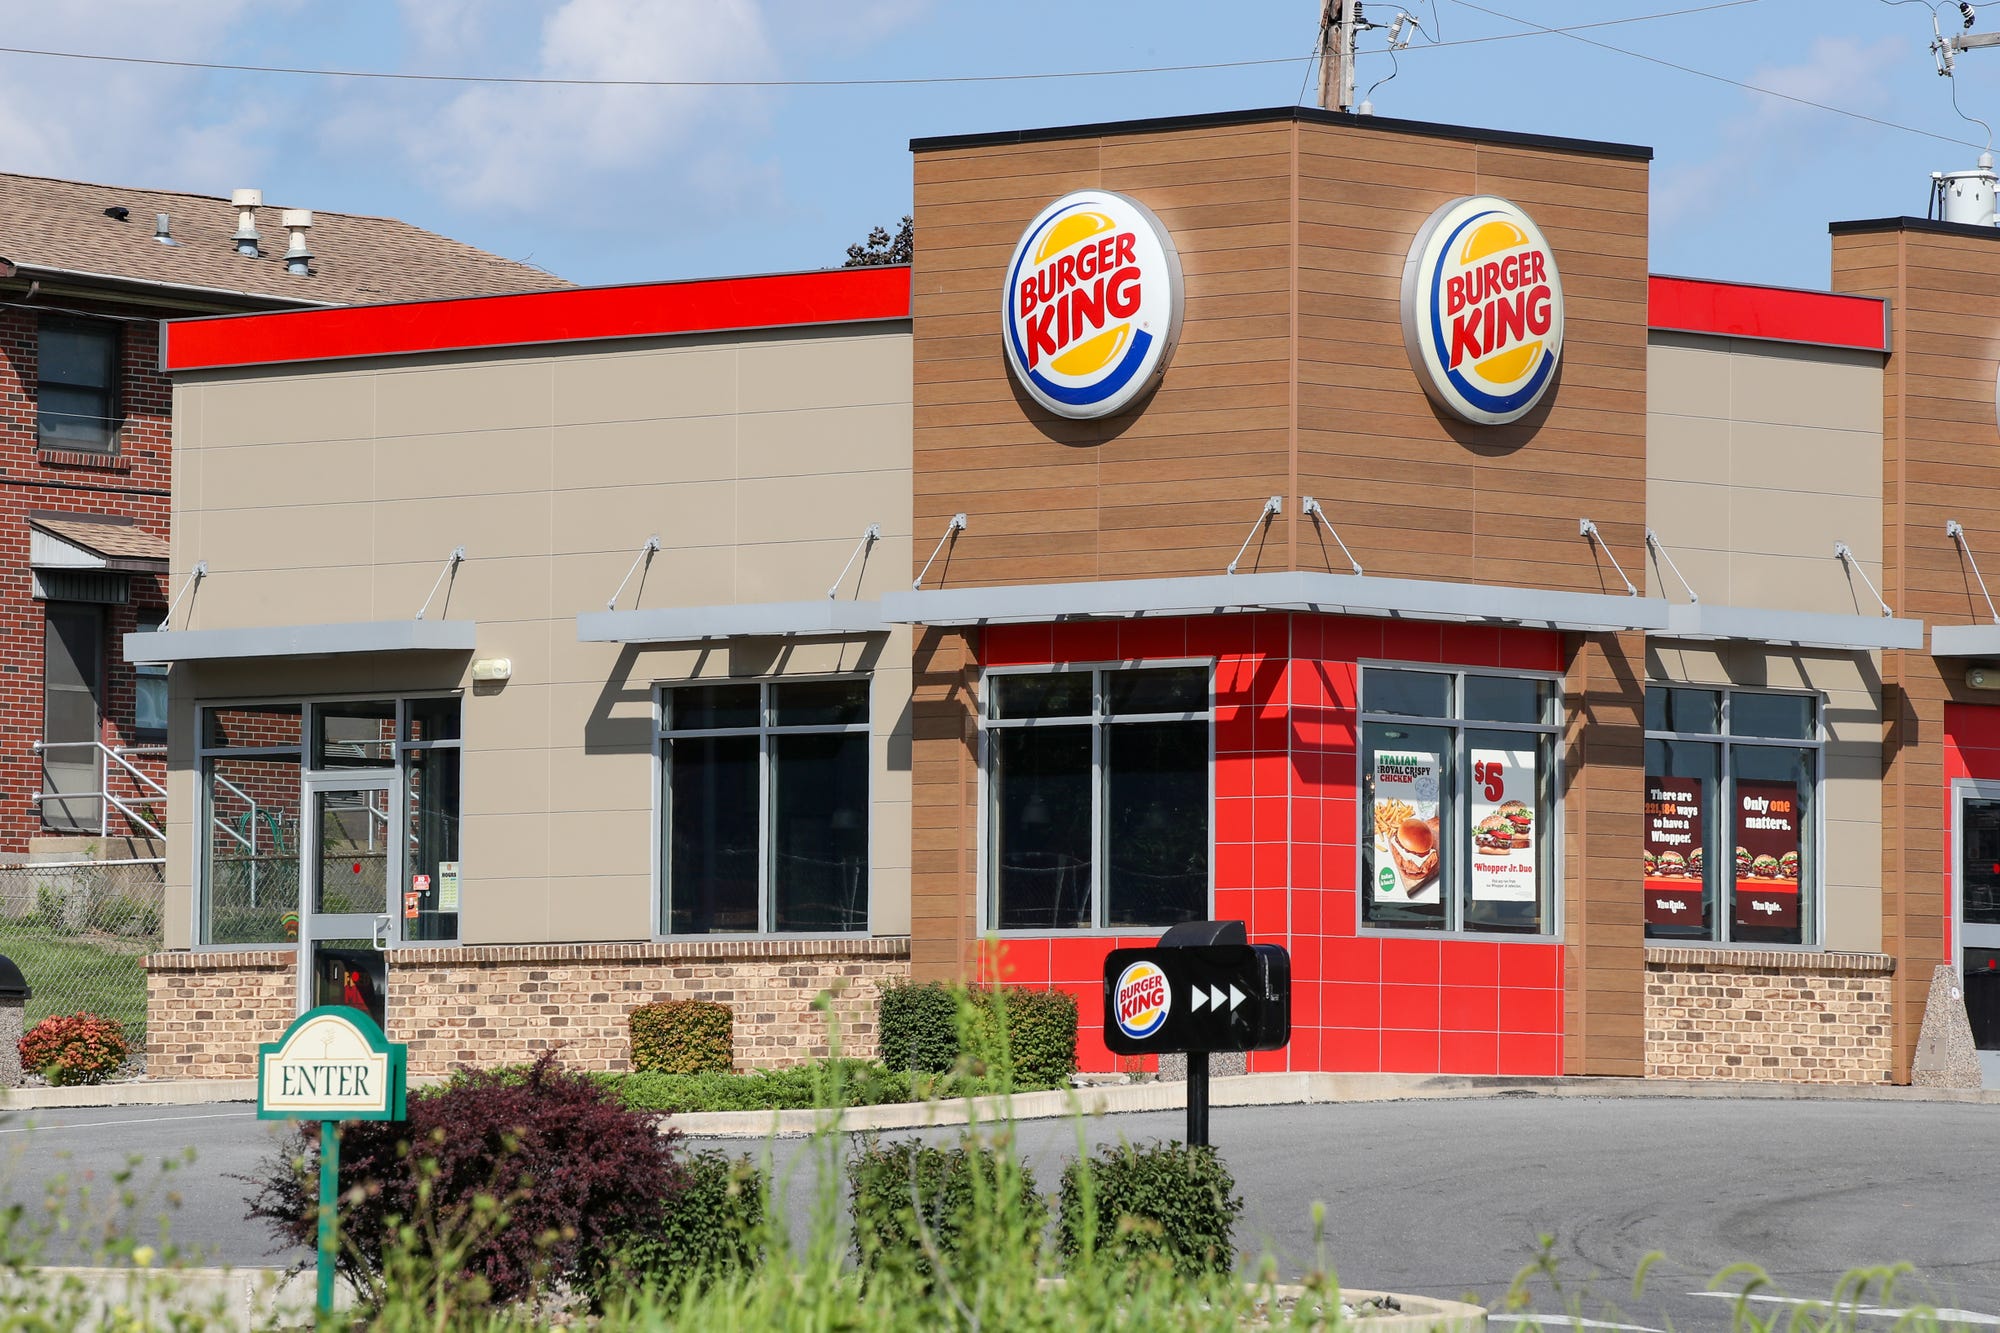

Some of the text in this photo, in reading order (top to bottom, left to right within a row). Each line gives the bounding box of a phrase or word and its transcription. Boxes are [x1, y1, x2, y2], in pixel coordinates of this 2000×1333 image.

[1020, 233, 1136, 318] BURGER
[1447, 251, 1547, 316] BURGER
[1026, 267, 1141, 369] KING
[1450, 285, 1551, 369] KING
[1380, 755, 1417, 766] ITALIAN
[1380, 766, 1404, 774] ROYAL
[1405, 767, 1431, 778] CRISPY
[1380, 774, 1413, 783] CHICKEN
[1475, 760, 1504, 802] $5
[1651, 789, 1692, 801] There are
[1645, 803, 1698, 818] 221,184 ways
[1743, 796, 1790, 815] Only one
[1653, 817, 1689, 829] to have a
[1745, 817, 1791, 830] matters.
[1474, 863, 1532, 874] Whopper Jr. Duo
[1669, 900, 1687, 914] Rule.
[1765, 902, 1782, 915] Rule.
[1120, 975, 1162, 1003] BURGER
[1121, 988, 1164, 1023] KING
[281, 1065, 370, 1096] ENTER
